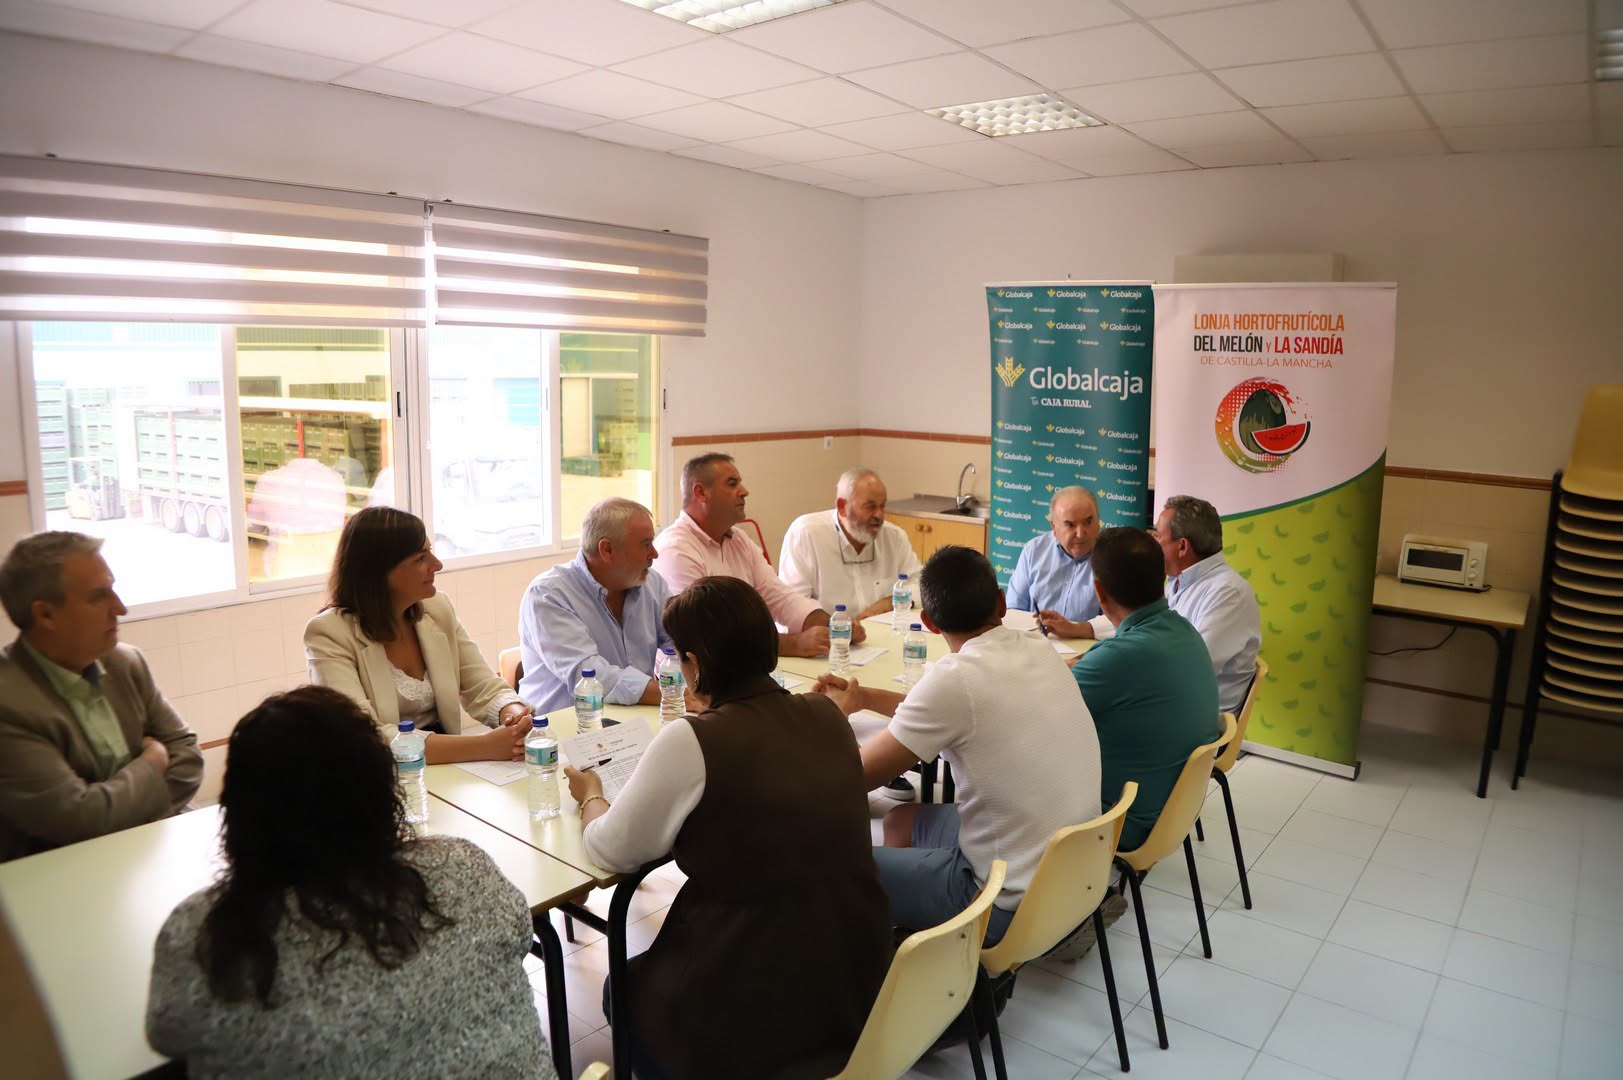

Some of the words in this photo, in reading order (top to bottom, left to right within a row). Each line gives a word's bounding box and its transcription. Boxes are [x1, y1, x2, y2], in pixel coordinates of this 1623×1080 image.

[1006, 291, 1032, 299] Globalcaja
[1056, 291, 1086, 299] Globalcaja
[1111, 290, 1142, 299] Globalcaja
[1004, 322, 1032, 330] Globalcaja
[1194, 313, 1230, 330] LONJA
[1234, 311, 1344, 331] HORTOFRUTÍCOLA
[1056, 322, 1086, 331] Globalcaja
[1109, 323, 1141, 332] Globalcaja
[1194, 335, 1216, 351] DEL
[1220, 333, 1262, 352] MELÓN
[1274, 336, 1290, 353] LA
[1294, 334, 1343, 354] SANDÍA
[1200, 356, 1213, 365] DE
[1217, 356, 1279, 367] CASTILLA-LA
[1283, 358, 1332, 368] MANCHA
[1030, 366, 1143, 400] Globalcaja
[1004, 422, 1031, 432] Globalcaja
[1056, 426, 1085, 435] Globalcaja
[1108, 430, 1139, 440] Globalcaja
[1004, 452, 1031, 462] Globalcaja
[1055, 456, 1084, 466] Globalcaja
[1107, 461, 1137, 472] Globalcaja
[1004, 482, 1031, 491] Globalcaja
[1106, 492, 1136, 503] Globalcaja
[1004, 511, 1031, 520] Globalcaja
